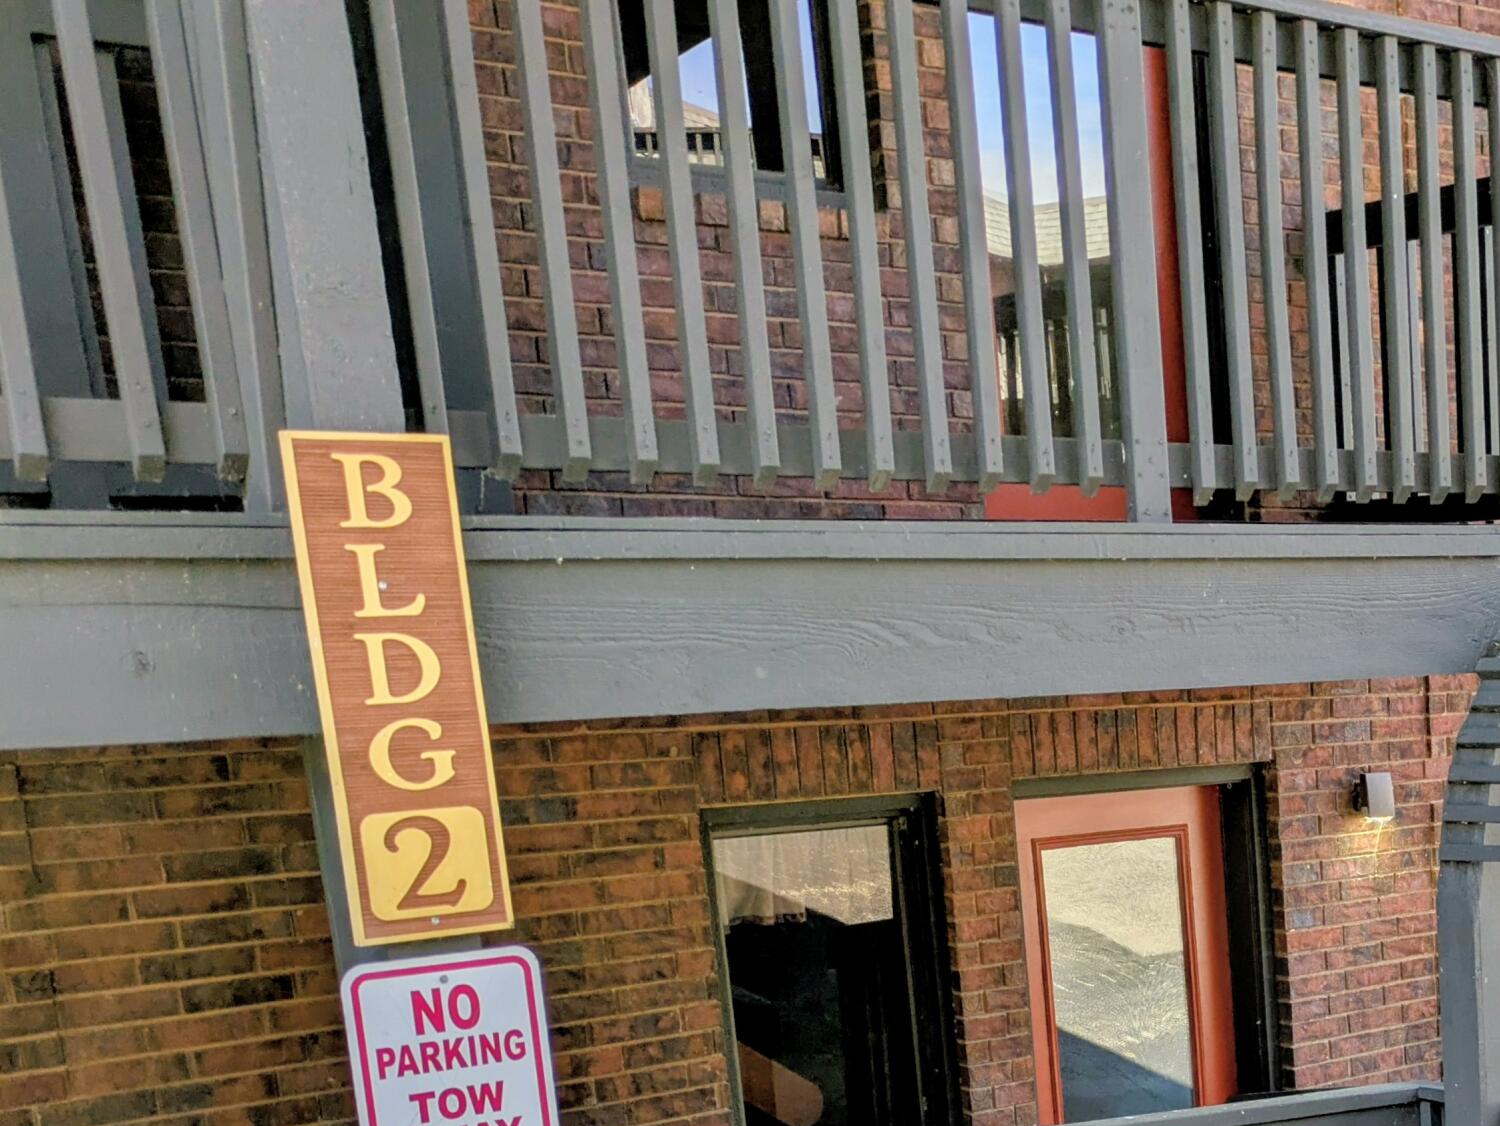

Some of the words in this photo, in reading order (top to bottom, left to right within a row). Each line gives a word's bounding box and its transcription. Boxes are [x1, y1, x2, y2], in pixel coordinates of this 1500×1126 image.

[331, 452, 456, 790] BLDG
[384, 816, 467, 911] 2
[410, 984, 480, 1035] NO
[376, 1029, 526, 1080] PARKING
[409, 1081, 504, 1123] TOW
